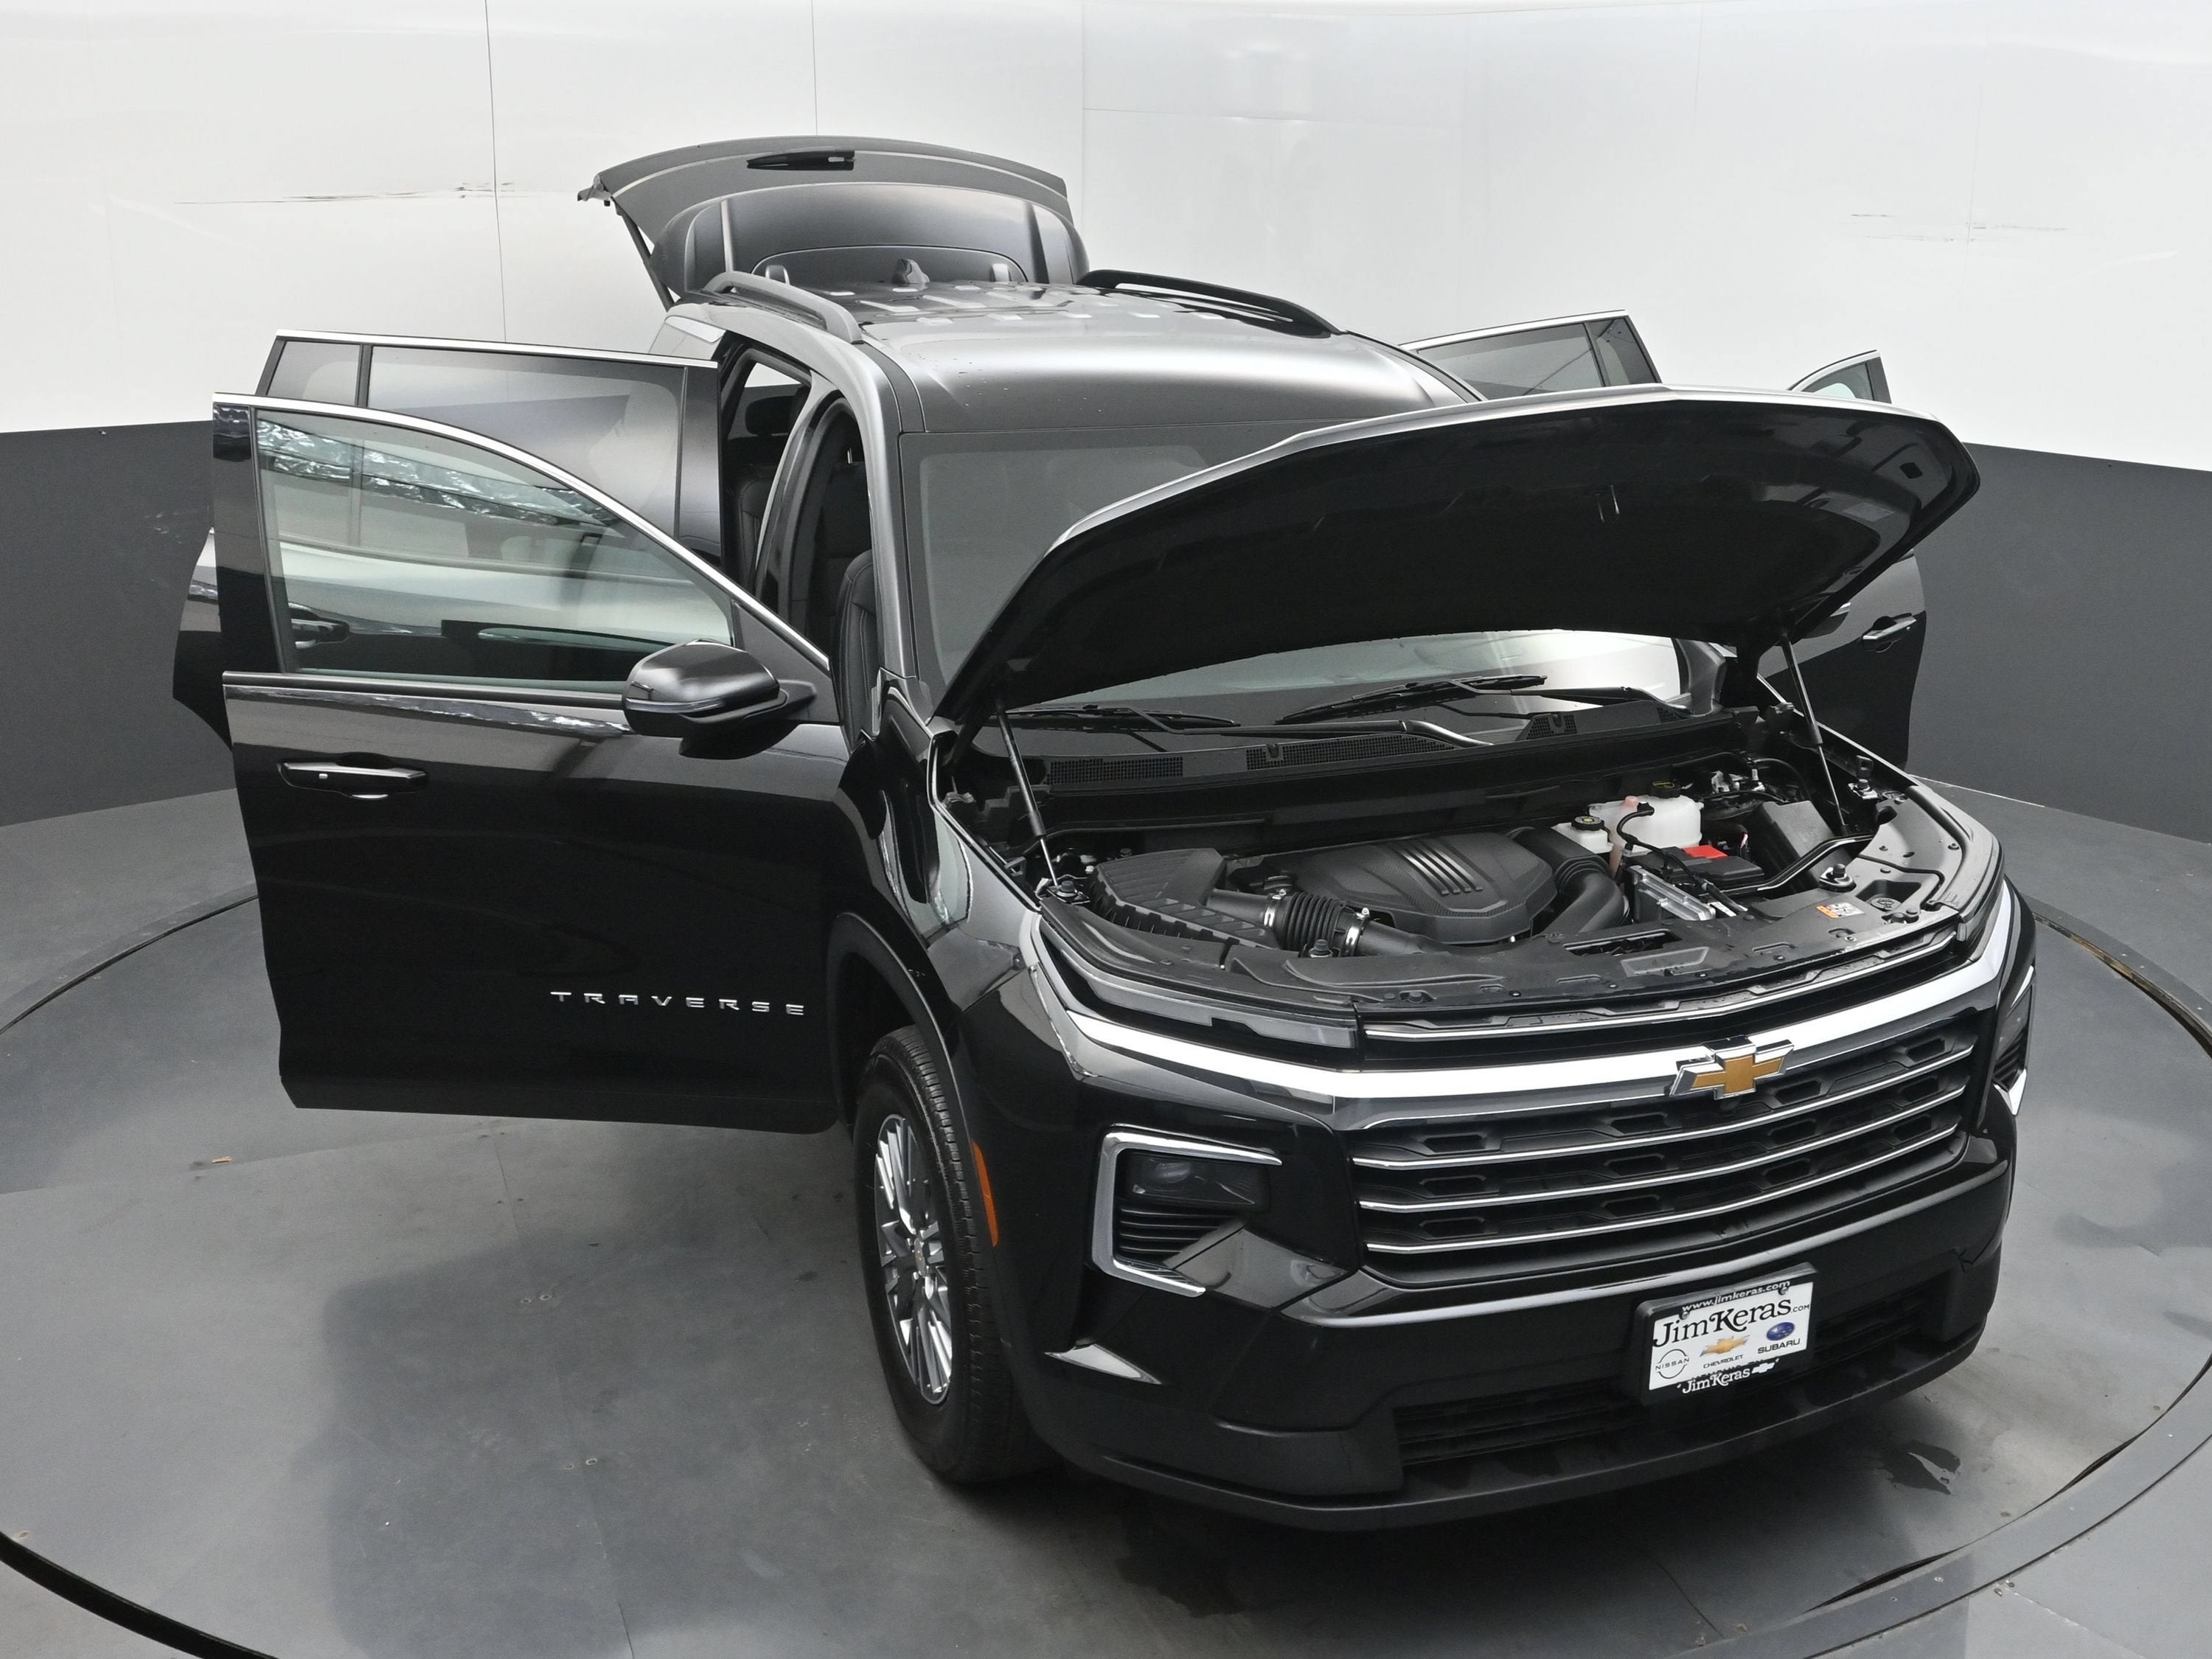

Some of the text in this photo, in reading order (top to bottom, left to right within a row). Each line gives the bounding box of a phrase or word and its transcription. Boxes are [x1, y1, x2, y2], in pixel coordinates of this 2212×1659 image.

[550, 992, 804, 1015] TRAVERSE
[1682, 1280, 1790, 1312] www.jimkeras.com
[1758, 1338, 1801, 1354] SUBARU
[1655, 1357, 1690, 1371] NISSAN
[1703, 1354, 1744, 1368] CHEVROLET
